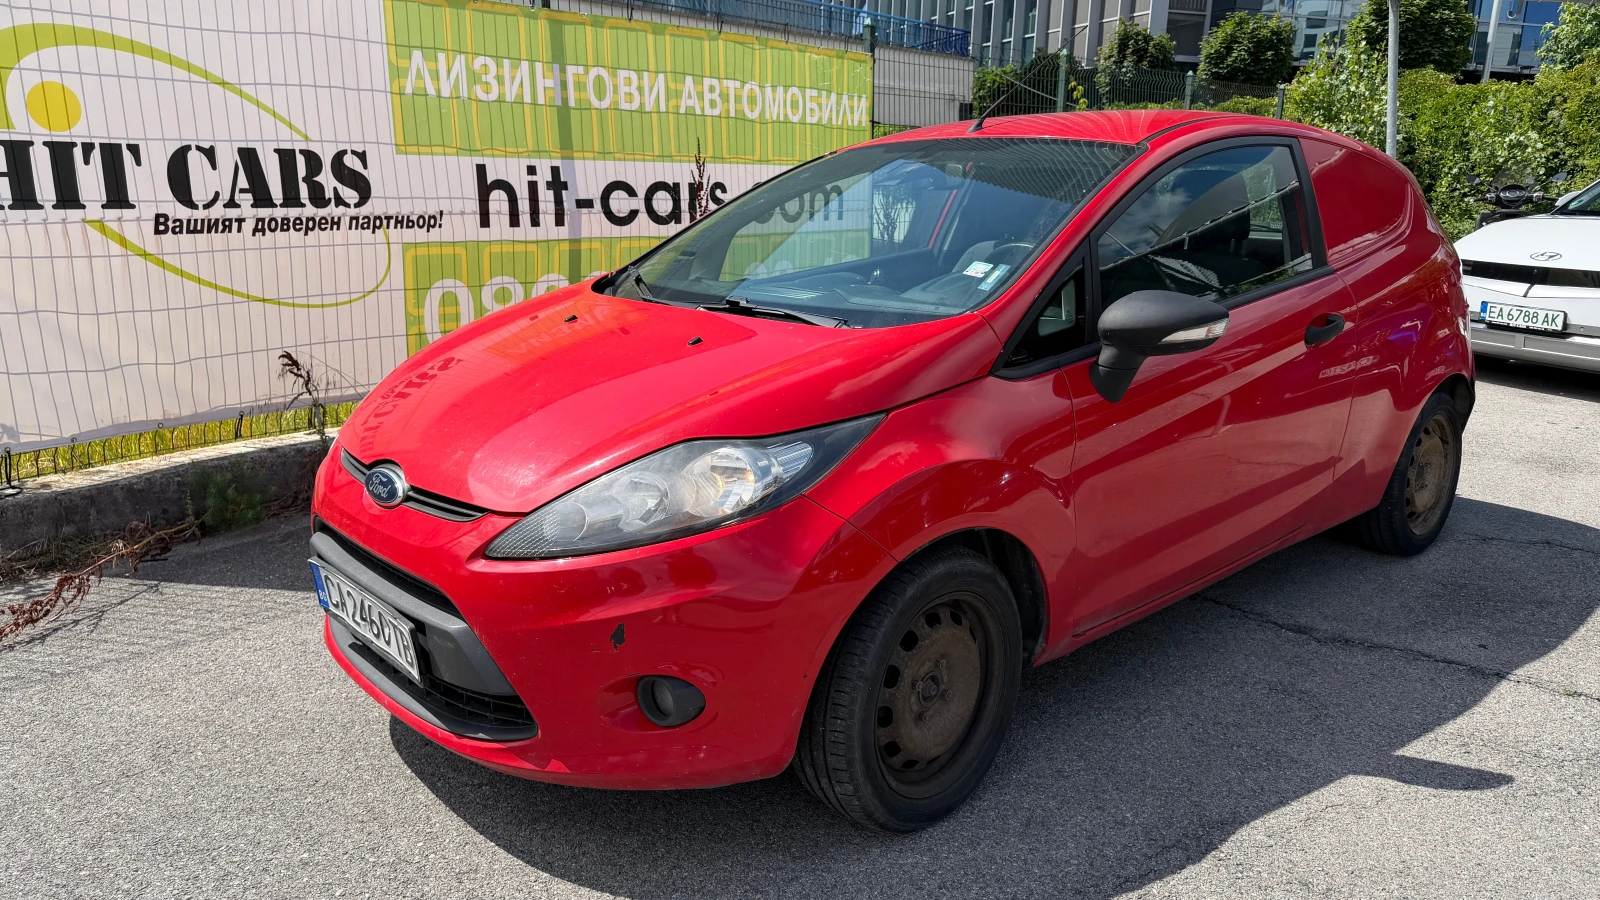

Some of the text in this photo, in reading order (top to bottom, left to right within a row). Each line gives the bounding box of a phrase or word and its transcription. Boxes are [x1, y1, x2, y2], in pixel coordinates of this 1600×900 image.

[405, 50, 867, 127] ЛИЗИНГОВИ АВТОМОБИЛИ
[166, 144, 373, 210] CARS
[153, 210, 443, 236] Вашият доверен партньор!
[1488, 305, 1504, 320] EA
[1507, 308, 1539, 324] 6788
[1541, 313, 1560, 327] AK
[368, 472, 392, 498] Ford
